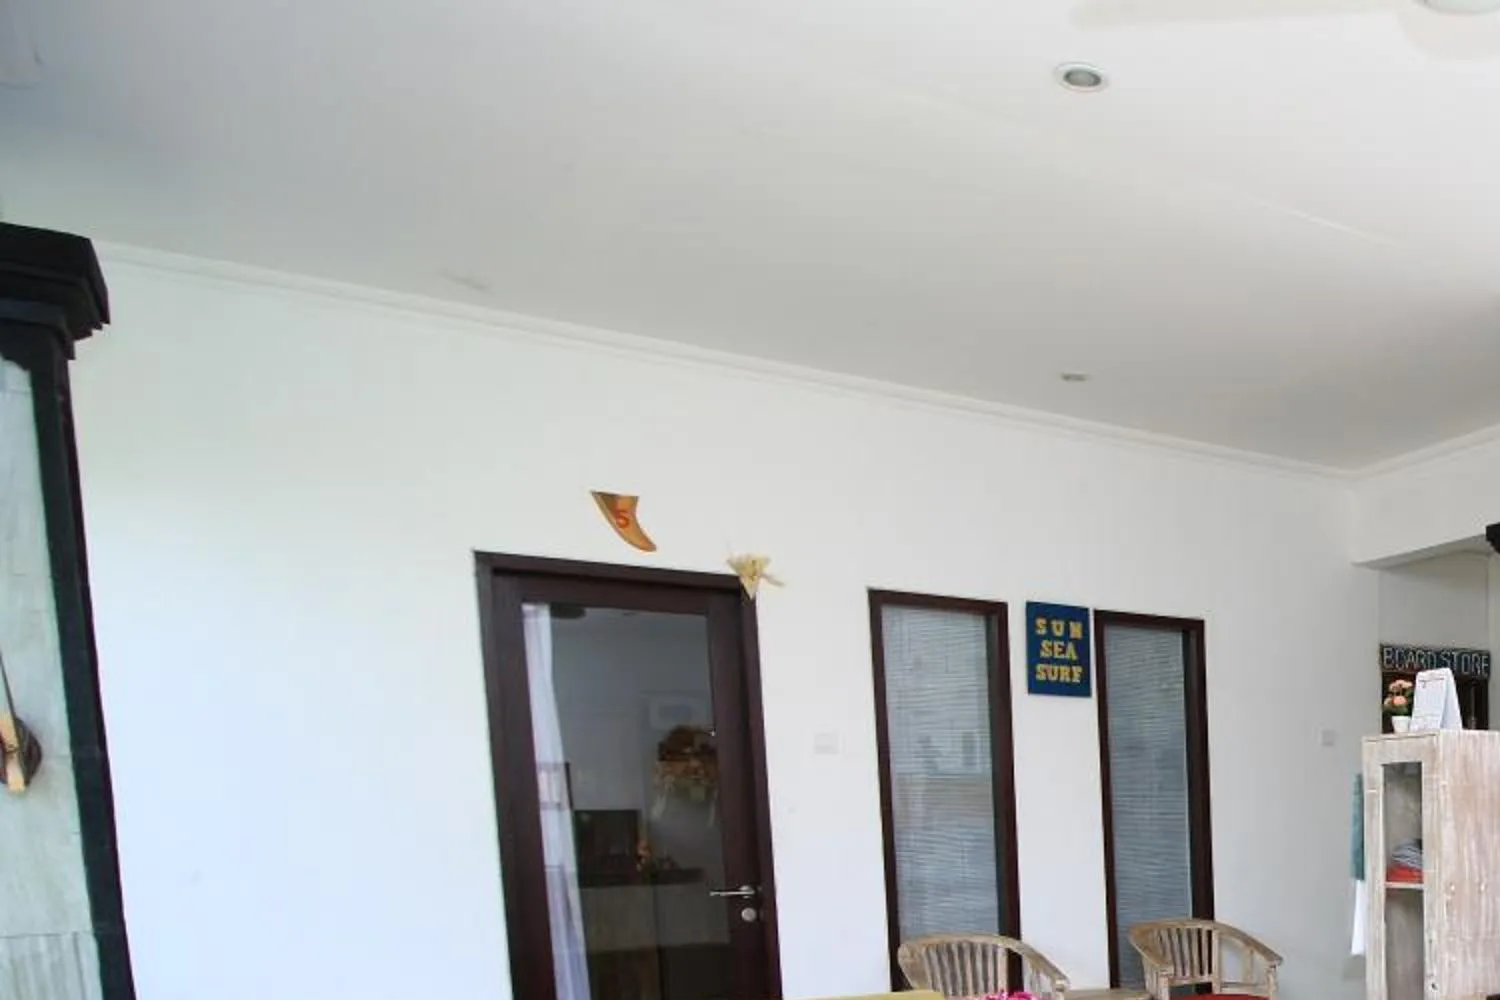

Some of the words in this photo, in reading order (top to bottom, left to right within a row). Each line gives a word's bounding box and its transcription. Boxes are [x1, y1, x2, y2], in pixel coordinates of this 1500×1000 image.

[1034, 616, 1083, 640] SUN
[1040, 639, 1078, 660] SEA
[1382, 646, 1437, 671] BOARD
[1439, 650, 1491, 678] STORE
[1035, 663, 1083, 684] SURF
